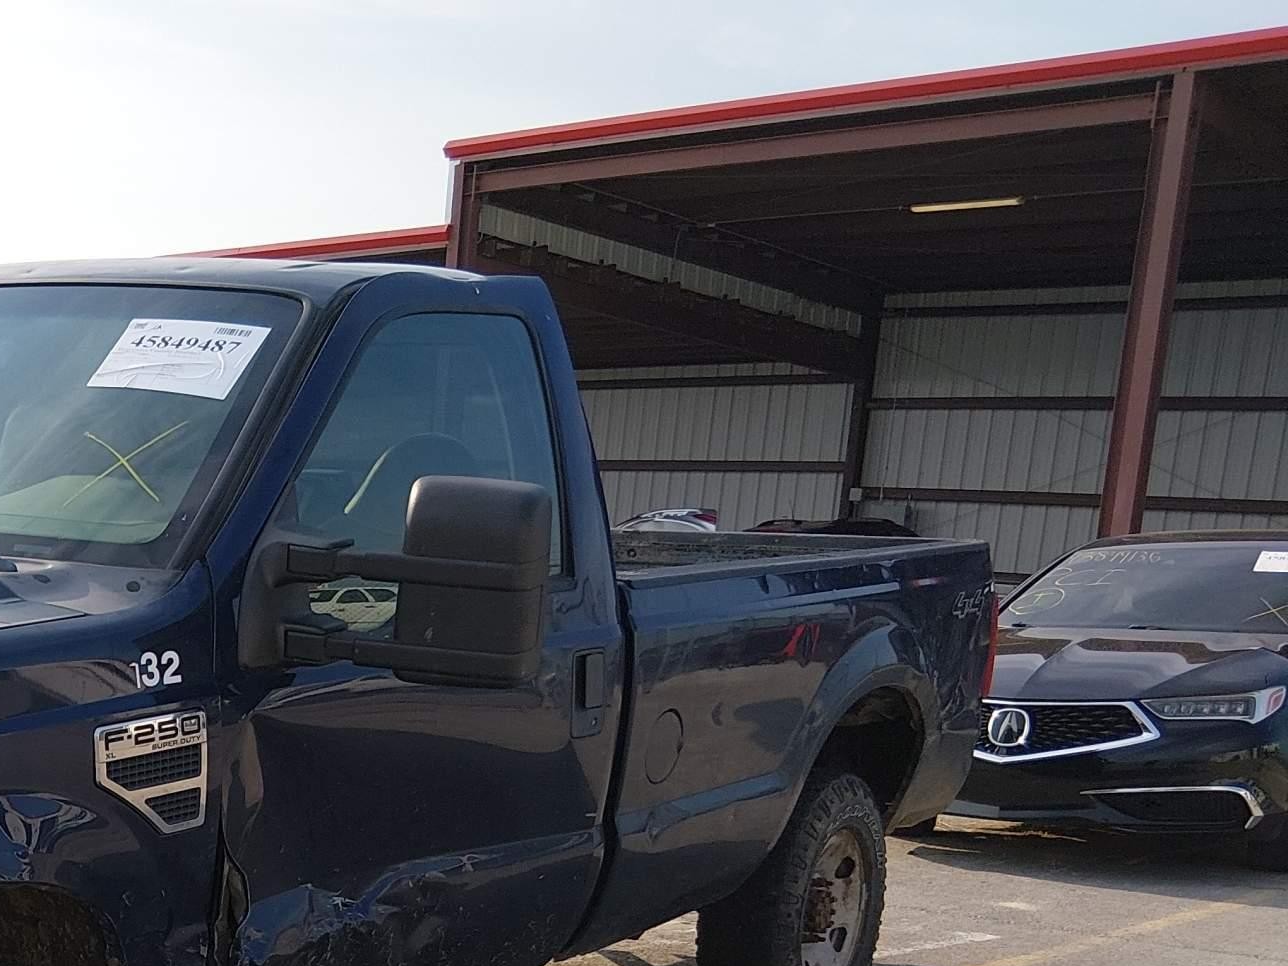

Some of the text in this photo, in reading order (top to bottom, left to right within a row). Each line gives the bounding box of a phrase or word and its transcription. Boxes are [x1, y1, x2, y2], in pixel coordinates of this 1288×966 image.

[131, 335, 242, 355] 45849487
[129, 650, 182, 689] 132
[104, 715, 201, 751] F-250
[152, 740, 178, 750] SUPER
